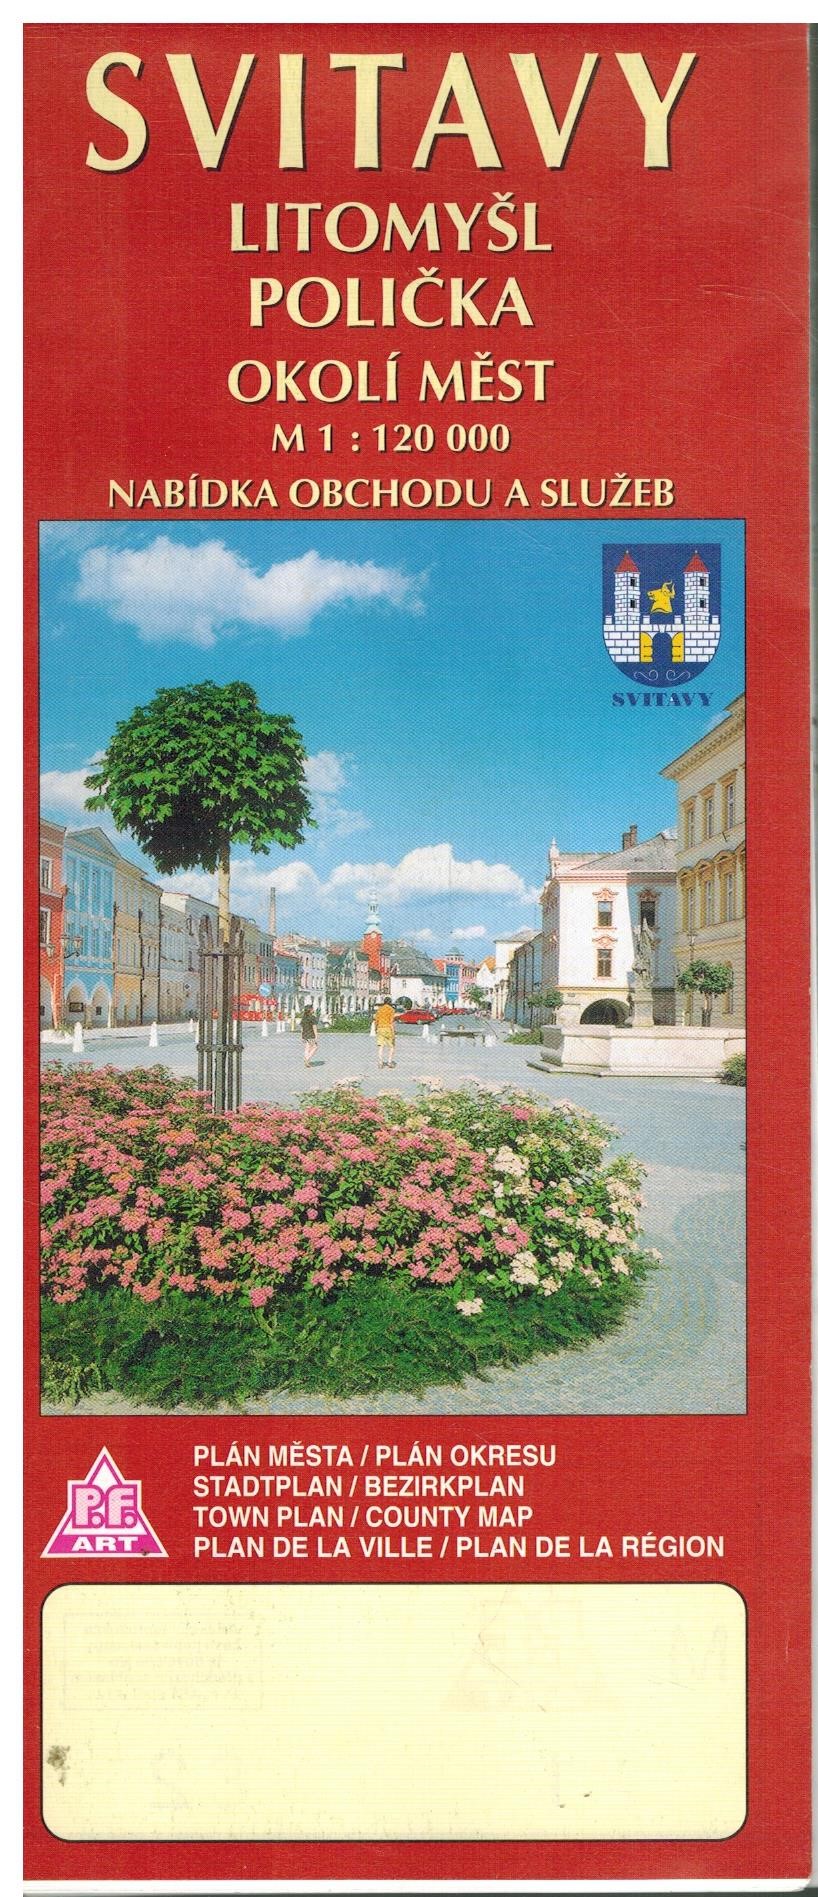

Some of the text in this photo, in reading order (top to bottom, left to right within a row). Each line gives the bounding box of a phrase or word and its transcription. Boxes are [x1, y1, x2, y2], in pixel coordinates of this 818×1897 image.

[86, 52, 697, 172] SVITAVY
[231, 191, 552, 253] LITOMYŠL
[250, 267, 534, 329] POLIČKA
[228, 352, 555, 403] OKOLÍ MĚST
[272, 424, 510, 452] M 1 : 120 000
[109, 473, 674, 508] NABÍDKA OBCHODU A SLUŽEB
[612, 693, 714, 707] SVITAVY
[195, 1440, 556, 1467] PLÁN MĚSTA / PLÁN OKRESU
[194, 1475, 524, 1498] STADTPLAN / BEZIRKPLAN
[72, 1484, 137, 1528] P.F.
[193, 1505, 533, 1528] TOWN PLAN / COUNTY MAP
[71, 1536, 139, 1552] ART
[195, 1531, 724, 1558] PLAN DE LA VILLE / PLAN DE LA RÉGION
